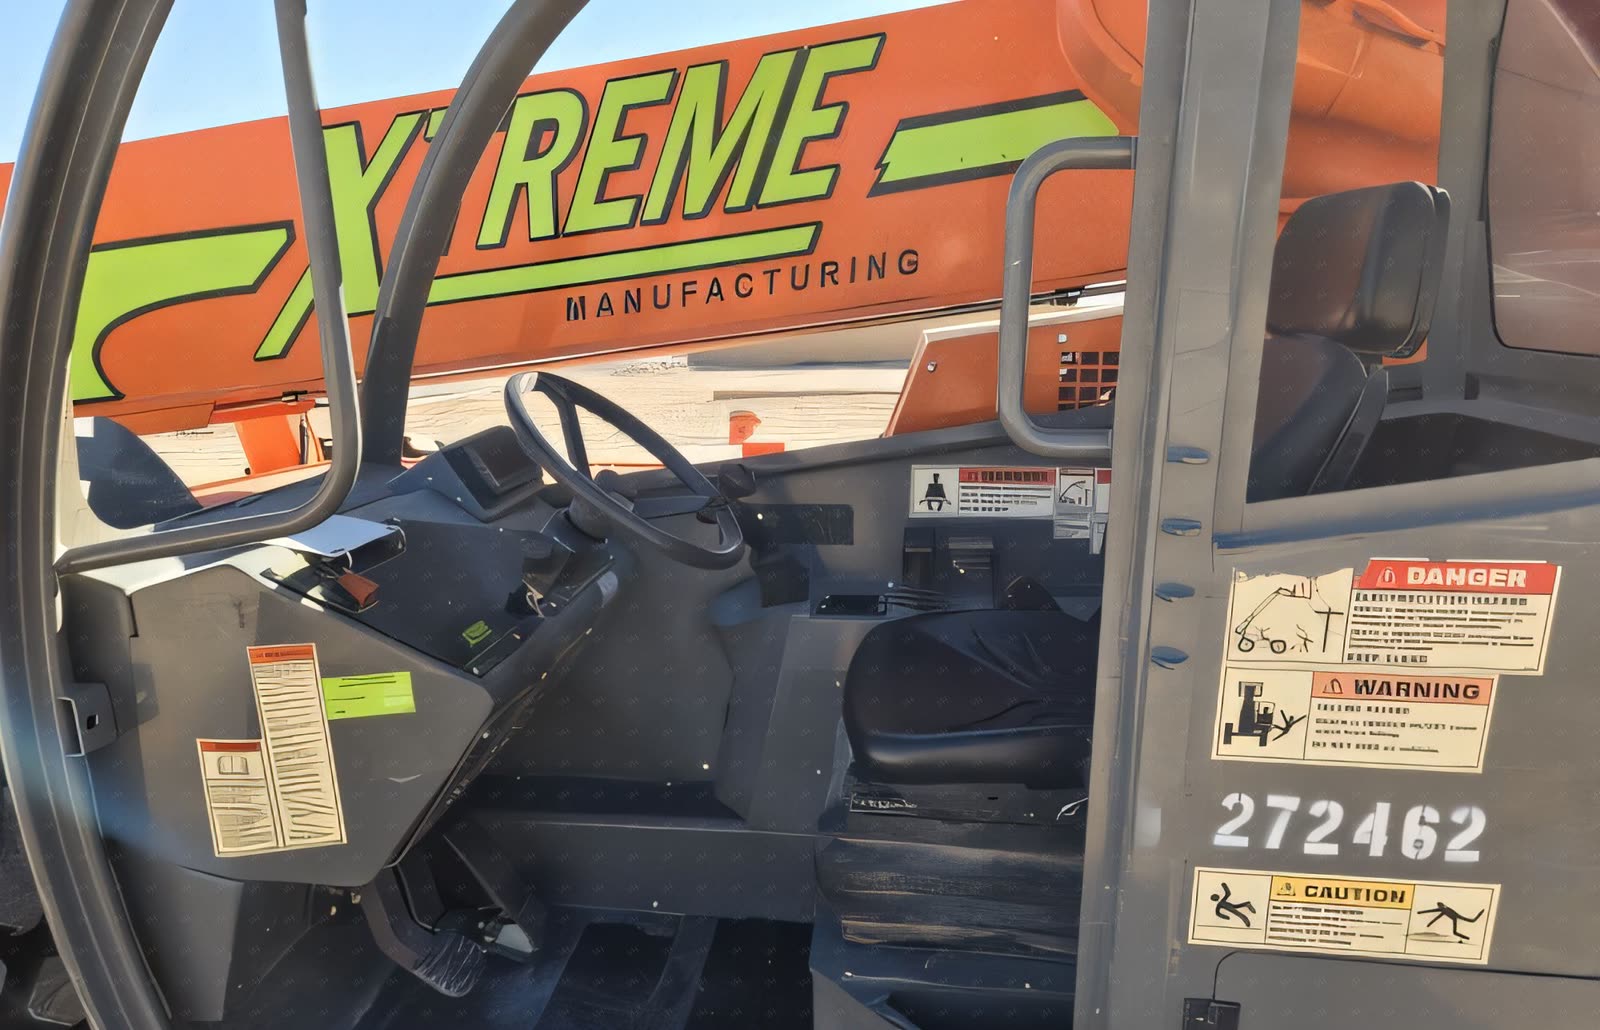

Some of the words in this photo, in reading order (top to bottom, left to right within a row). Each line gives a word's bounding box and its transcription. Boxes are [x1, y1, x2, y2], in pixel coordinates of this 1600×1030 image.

[254, 33, 886, 360] XREME
[566, 249, 920, 321] MANUFACTURING
[1407, 567, 1527, 588] DANGER
[1354, 679, 1480, 700] WARNING
[1212, 792, 1487, 863] 272462
[1304, 885, 1406, 904] CAUTION
